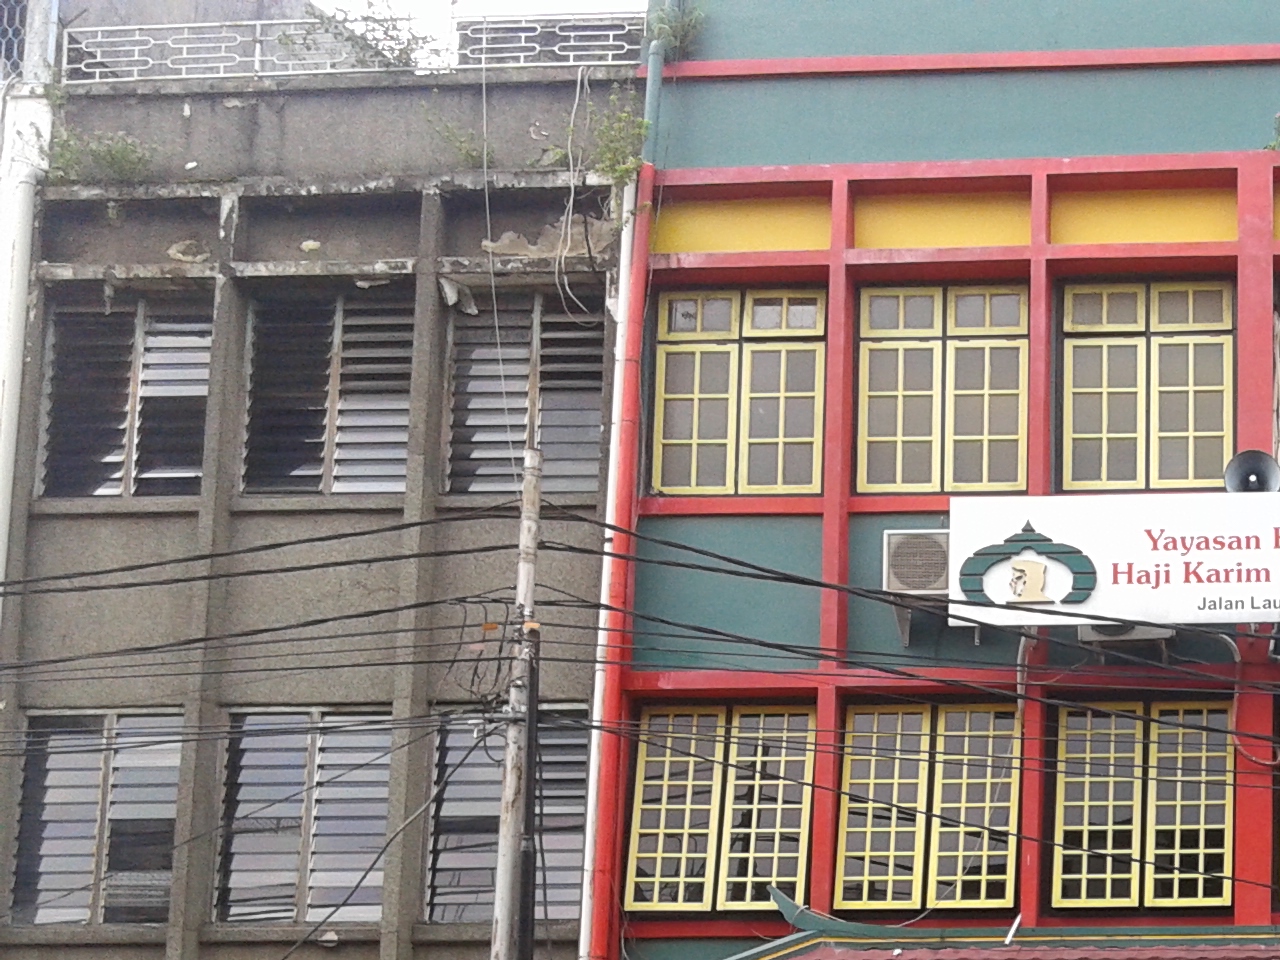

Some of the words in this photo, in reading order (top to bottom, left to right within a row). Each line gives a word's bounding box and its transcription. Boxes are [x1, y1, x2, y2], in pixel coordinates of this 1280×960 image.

[1144, 528, 1261, 555] Yayasan
[1111, 562, 1171, 589] Haji
[1183, 561, 1271, 584] Karim
[1197, 597, 1245, 611] Jalan
